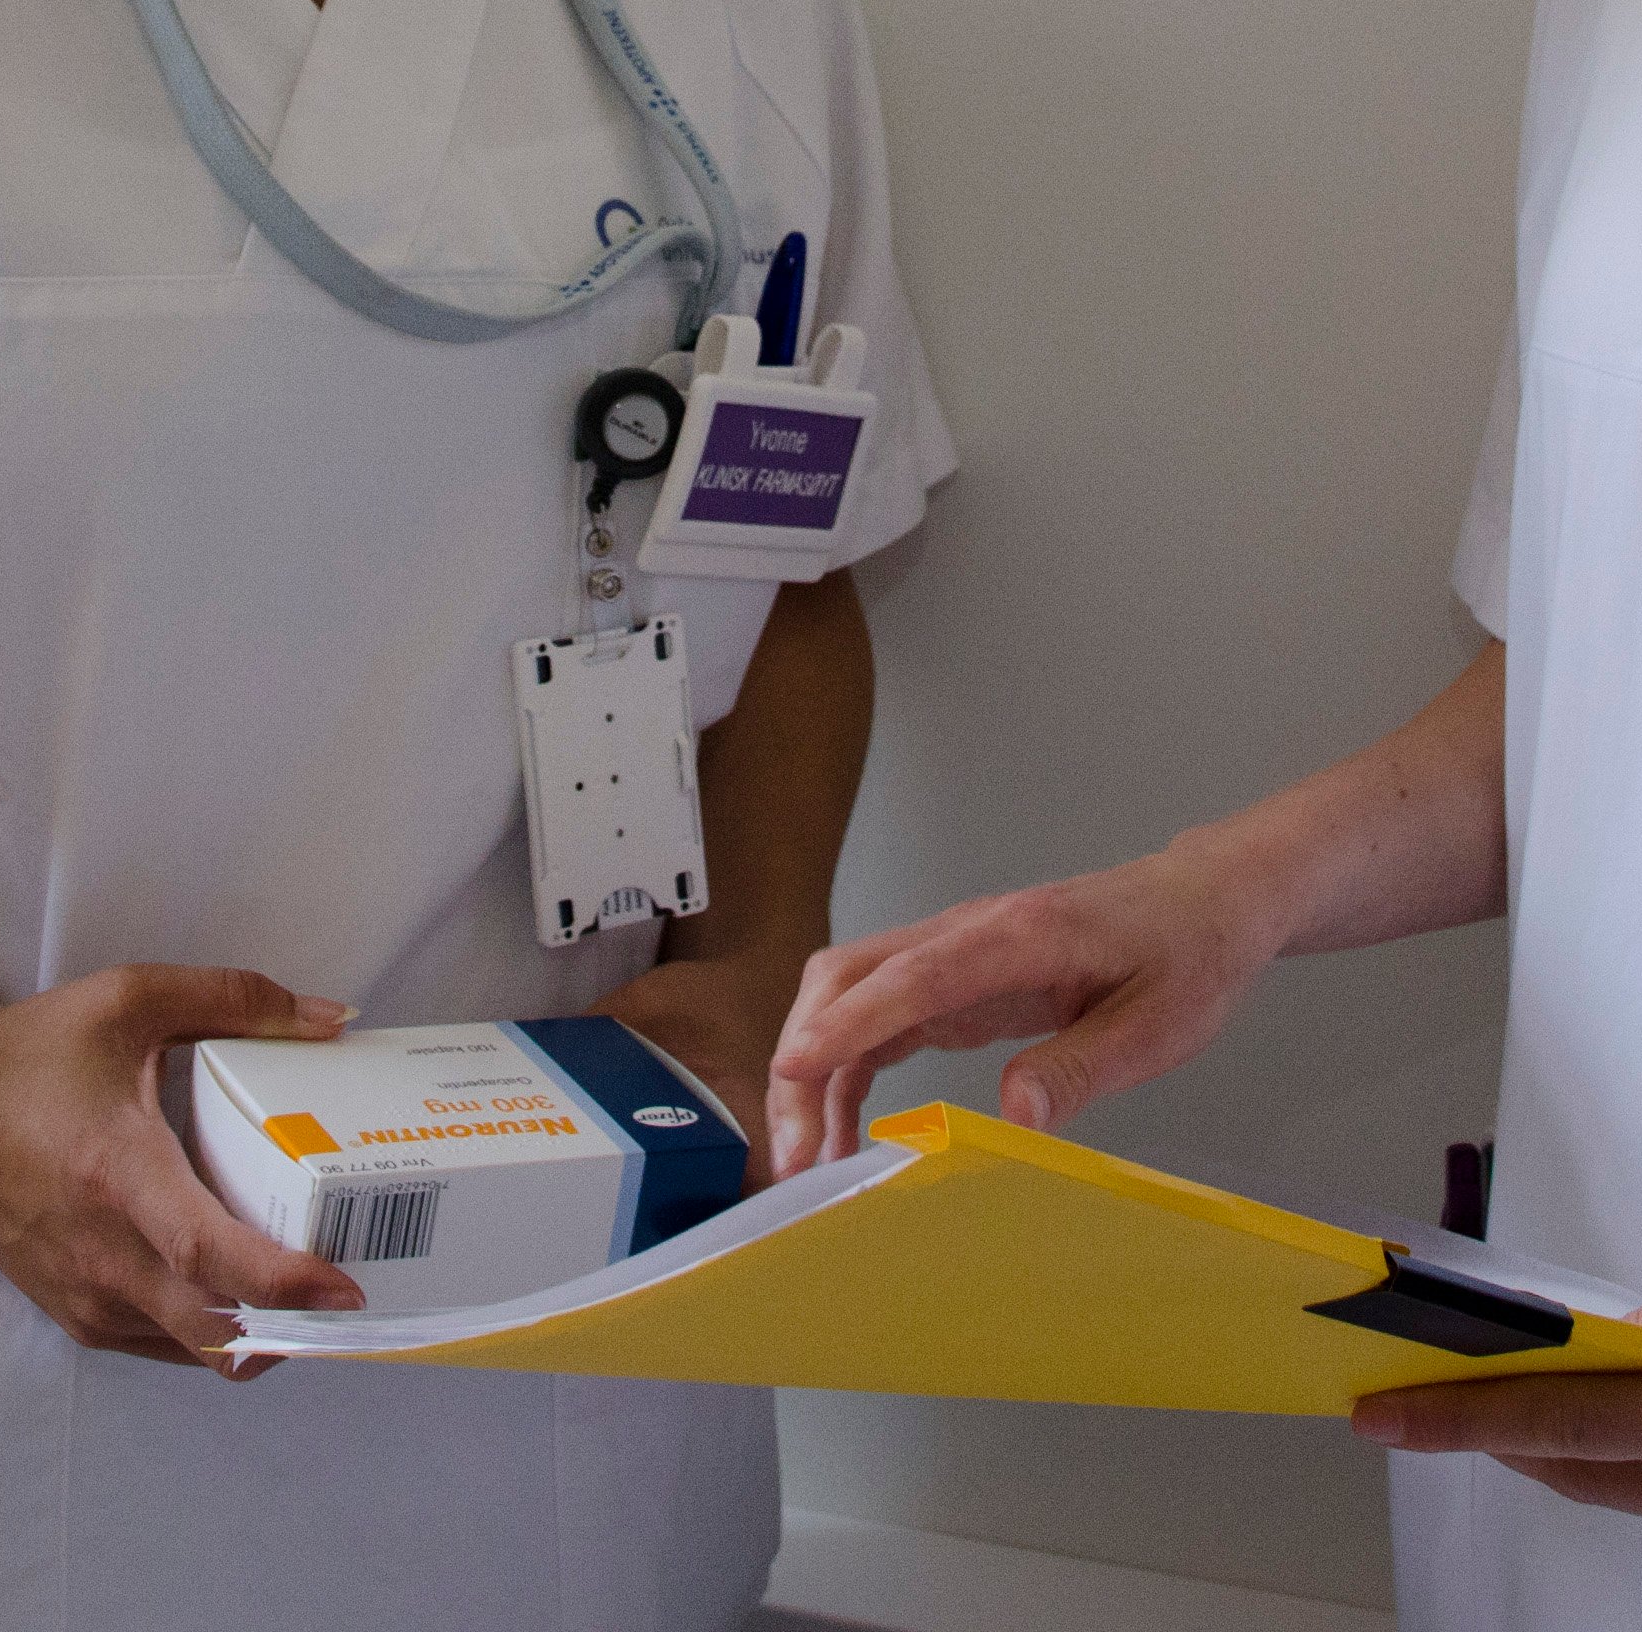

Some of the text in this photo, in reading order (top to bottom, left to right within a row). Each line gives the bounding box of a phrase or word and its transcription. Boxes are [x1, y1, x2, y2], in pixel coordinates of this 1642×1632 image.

[749, 418, 809, 455] Yvonne
[693, 463, 756, 492] KLINISK
[421, 1094, 556, 1115] 300 mg
[319, 1157, 435, 1175] Vnr 09 77 90
